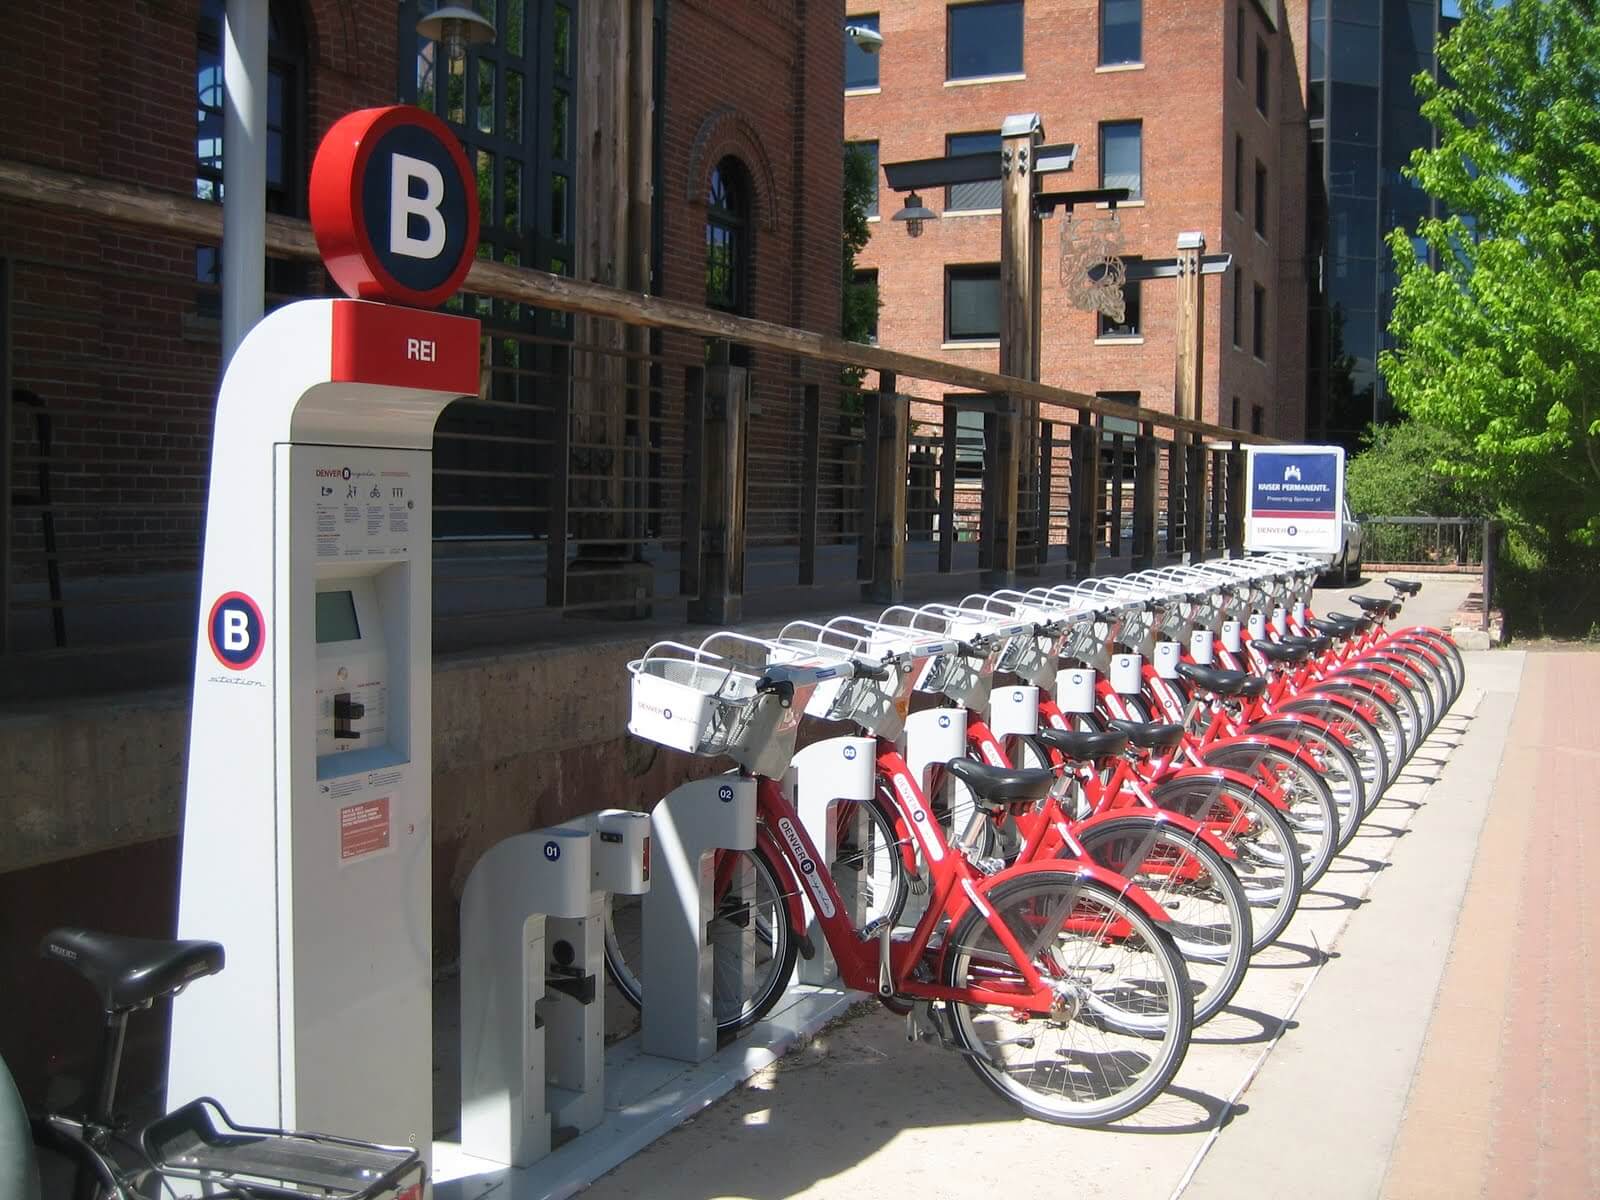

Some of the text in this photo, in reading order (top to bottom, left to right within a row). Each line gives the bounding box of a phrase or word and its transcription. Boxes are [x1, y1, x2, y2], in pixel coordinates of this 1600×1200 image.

[390, 152, 447, 259] B
[407, 338, 436, 362] REI
[223, 609, 250, 651] B
[207, 675, 267, 687] station
[720, 789, 732, 799] 02
[546, 846, 558, 857] 01
[781, 821, 812, 872] DENVER B
